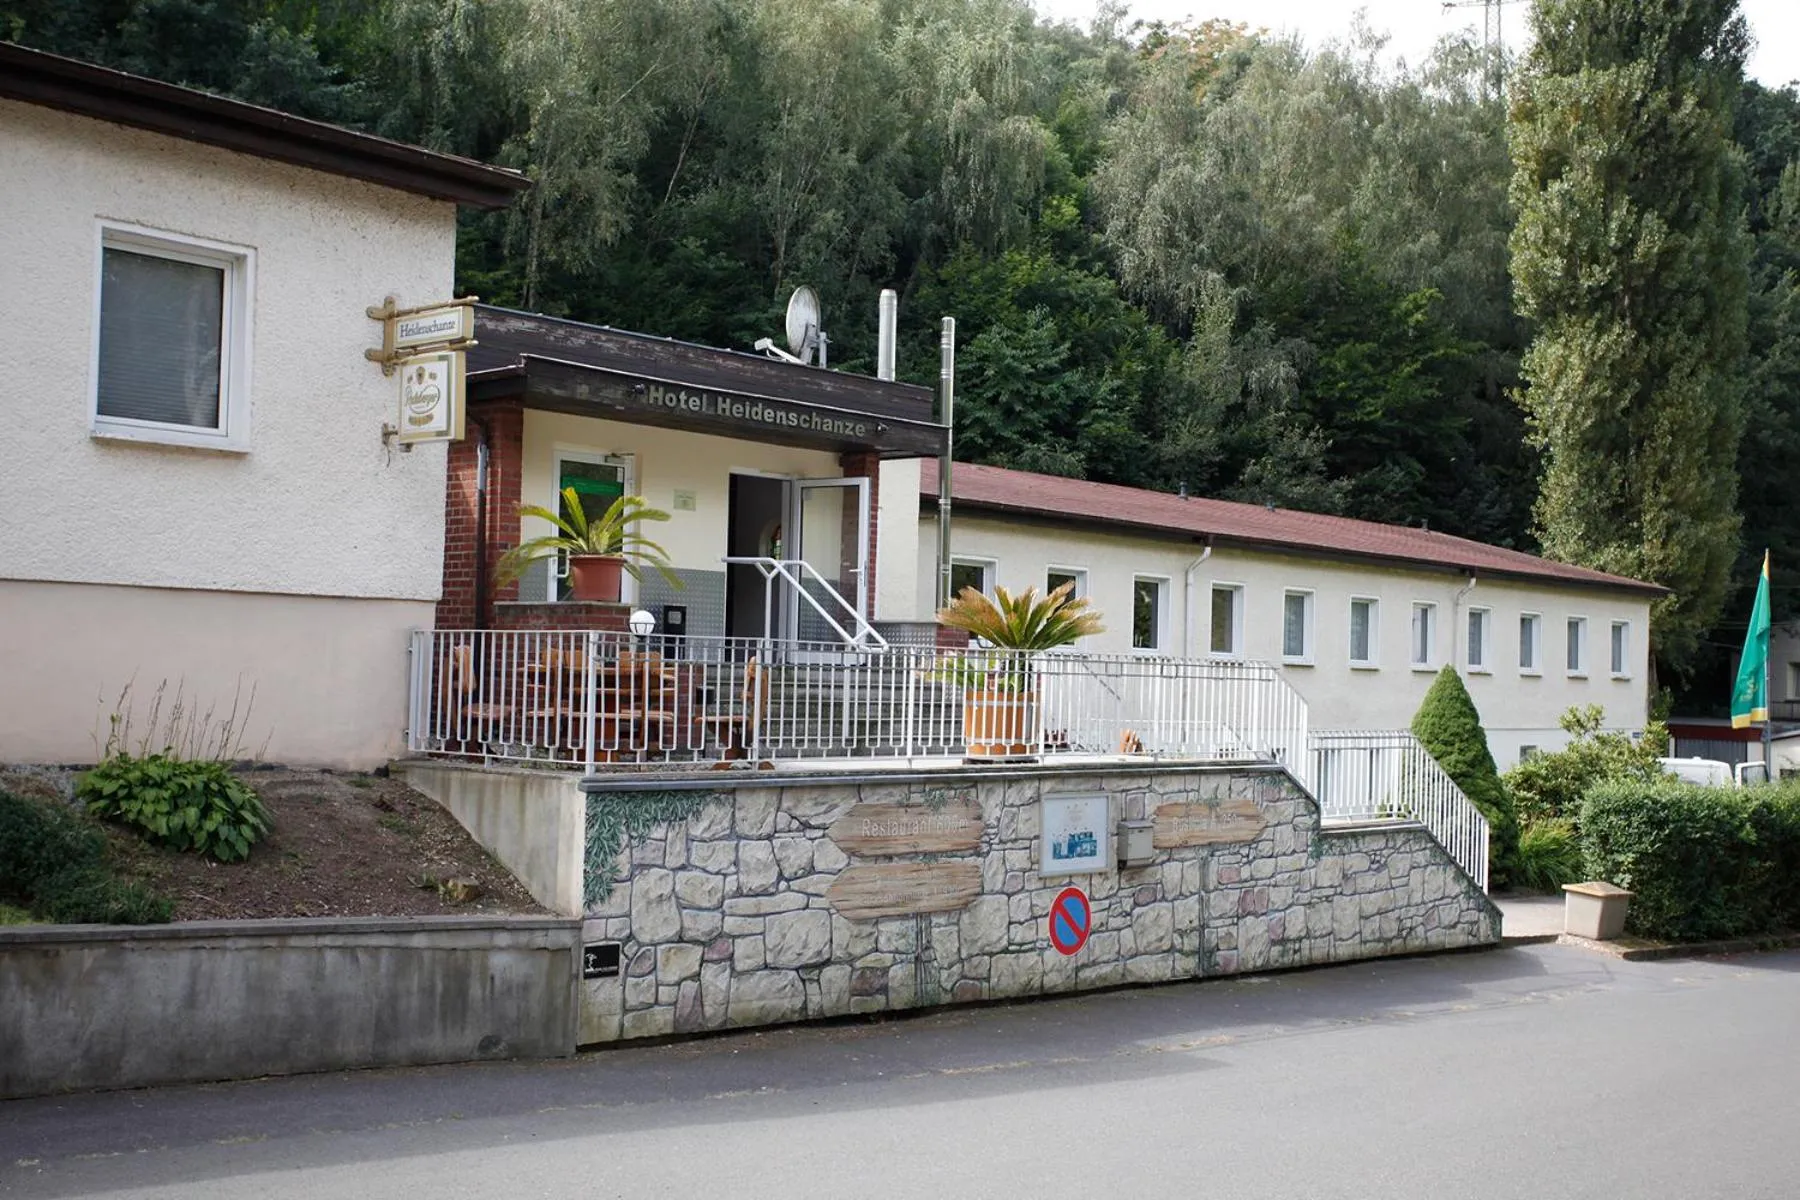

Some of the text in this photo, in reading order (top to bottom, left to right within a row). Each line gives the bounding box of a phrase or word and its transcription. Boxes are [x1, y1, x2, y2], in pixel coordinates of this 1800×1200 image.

[400, 320, 456, 338] Heidenschanze
[649, 384, 866, 437] Hotel Heidenschanze
